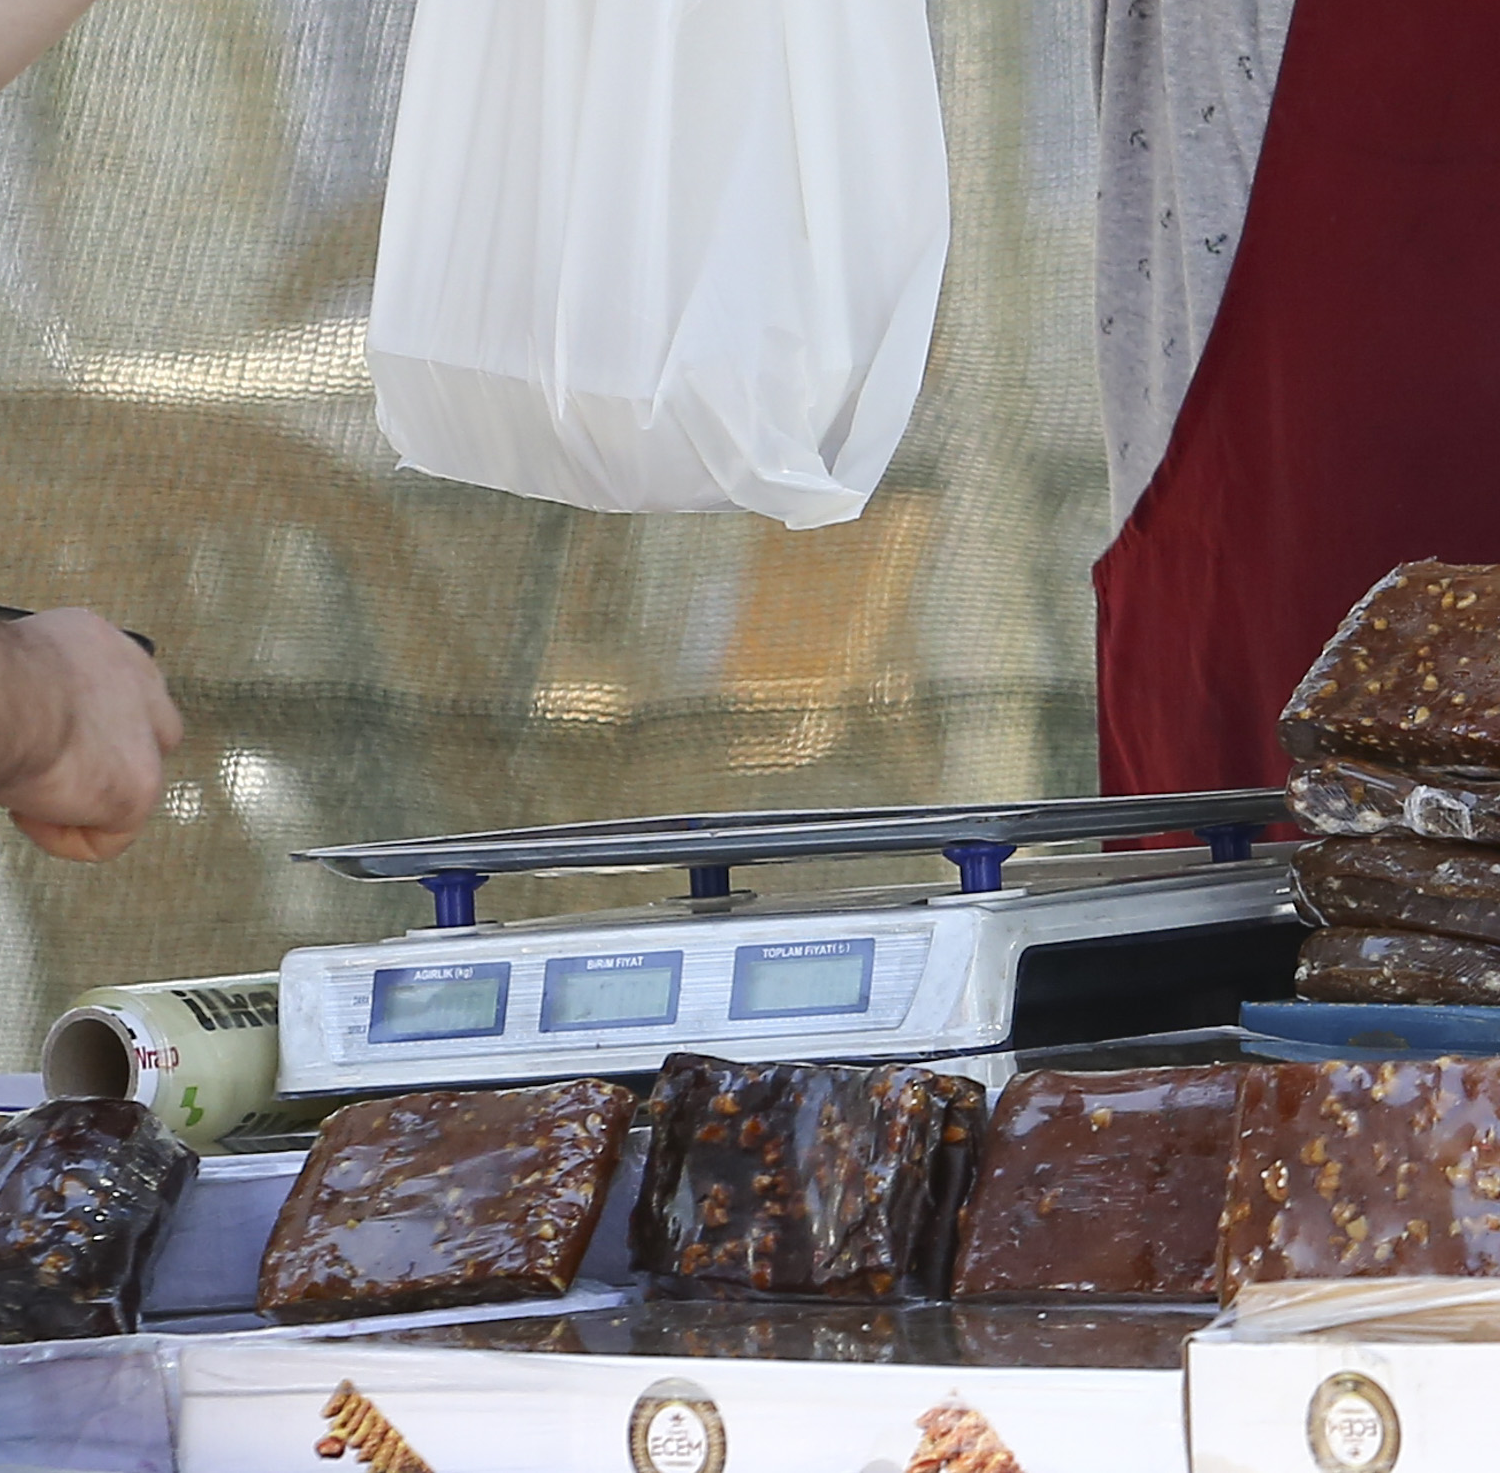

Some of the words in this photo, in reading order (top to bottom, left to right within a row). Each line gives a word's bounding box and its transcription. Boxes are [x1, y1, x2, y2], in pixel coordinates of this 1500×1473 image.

[762, 946, 803, 959] TOPLAM
[615, 955, 645, 969] FİYAT
[454, 966, 474, 980] (kg)
[650, 1436, 703, 1457] ECEM
